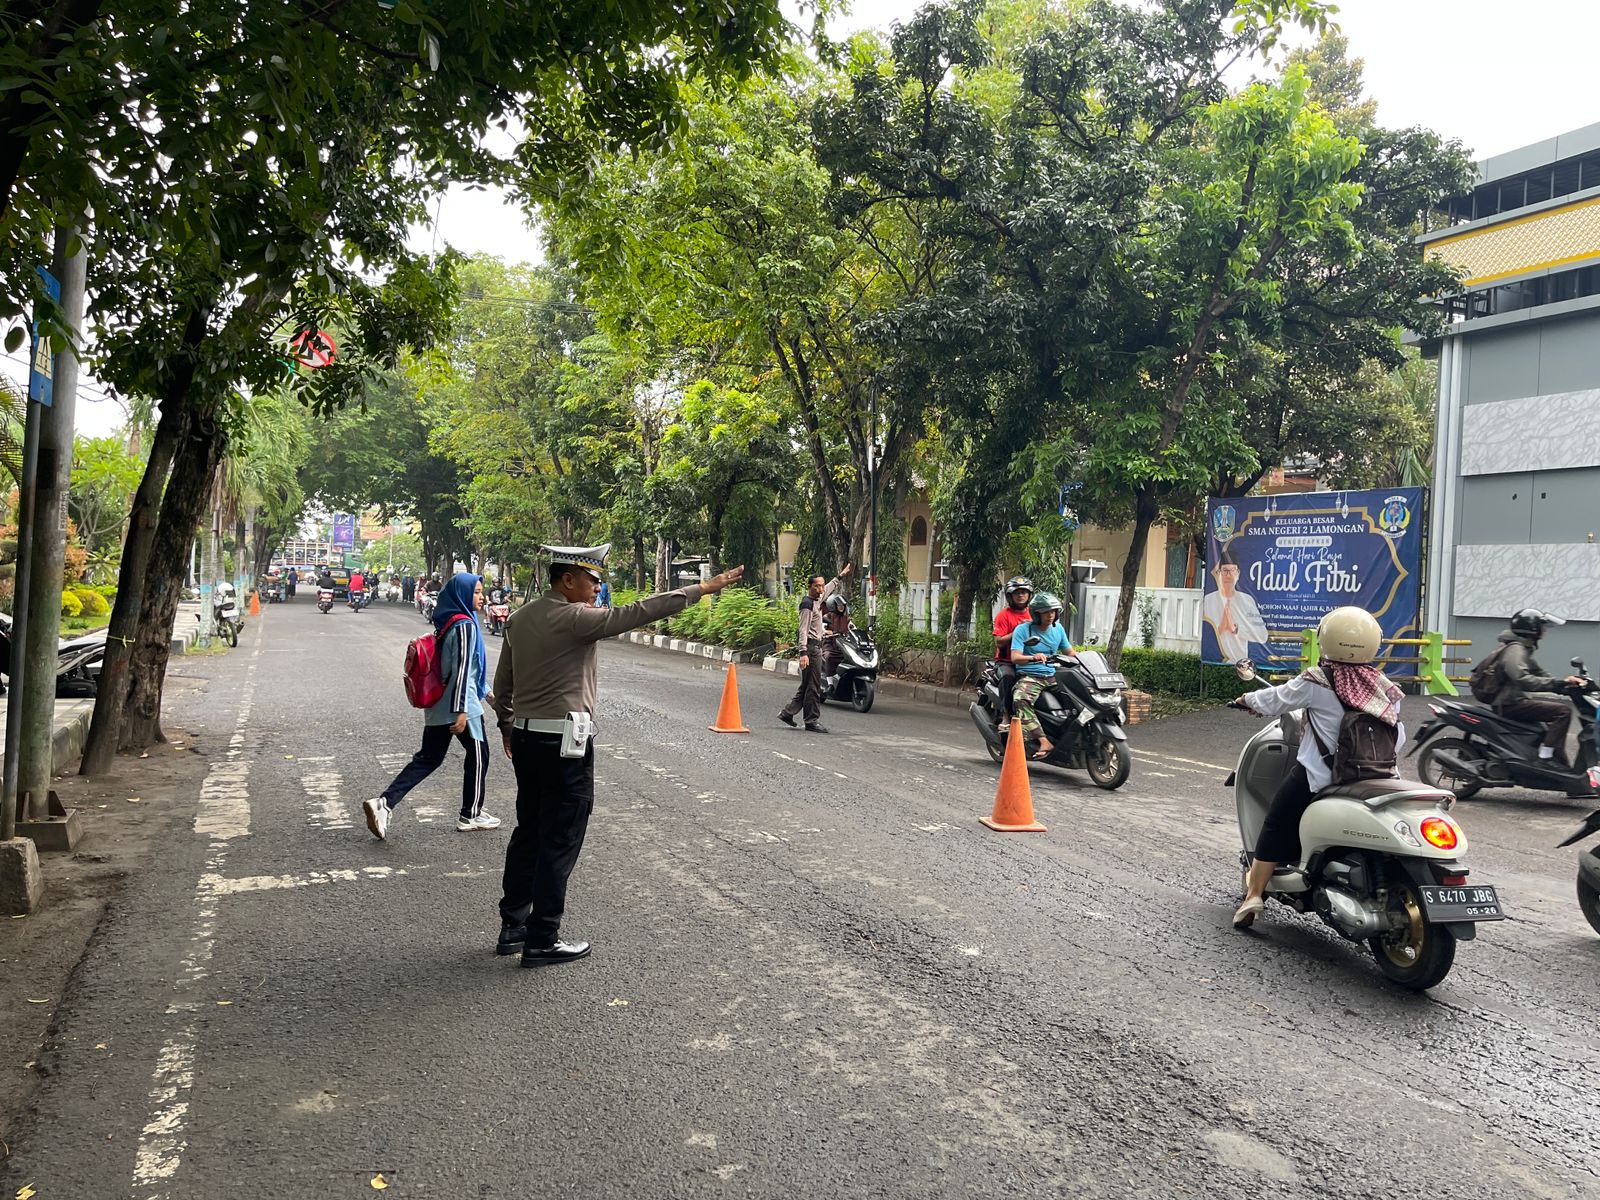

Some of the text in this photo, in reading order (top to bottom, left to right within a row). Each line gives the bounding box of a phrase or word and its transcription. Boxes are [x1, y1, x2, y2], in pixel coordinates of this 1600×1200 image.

[1312, 516, 1335, 524] BESAR
[1248, 524, 1365, 536] SMA NEGERI 2 LAMONGAN
[1278, 537, 1330, 545] MENGUCAPKAN
[1264, 546, 1342, 565] Selamat Hari Raya
[1249, 560, 1362, 594] Idul Fitri
[1257, 603, 1282, 611] MOHON
[1342, 829, 1389, 840] SCOOPY
[1426, 891, 1434, 903] S
[1439, 890, 1467, 903] 6470
